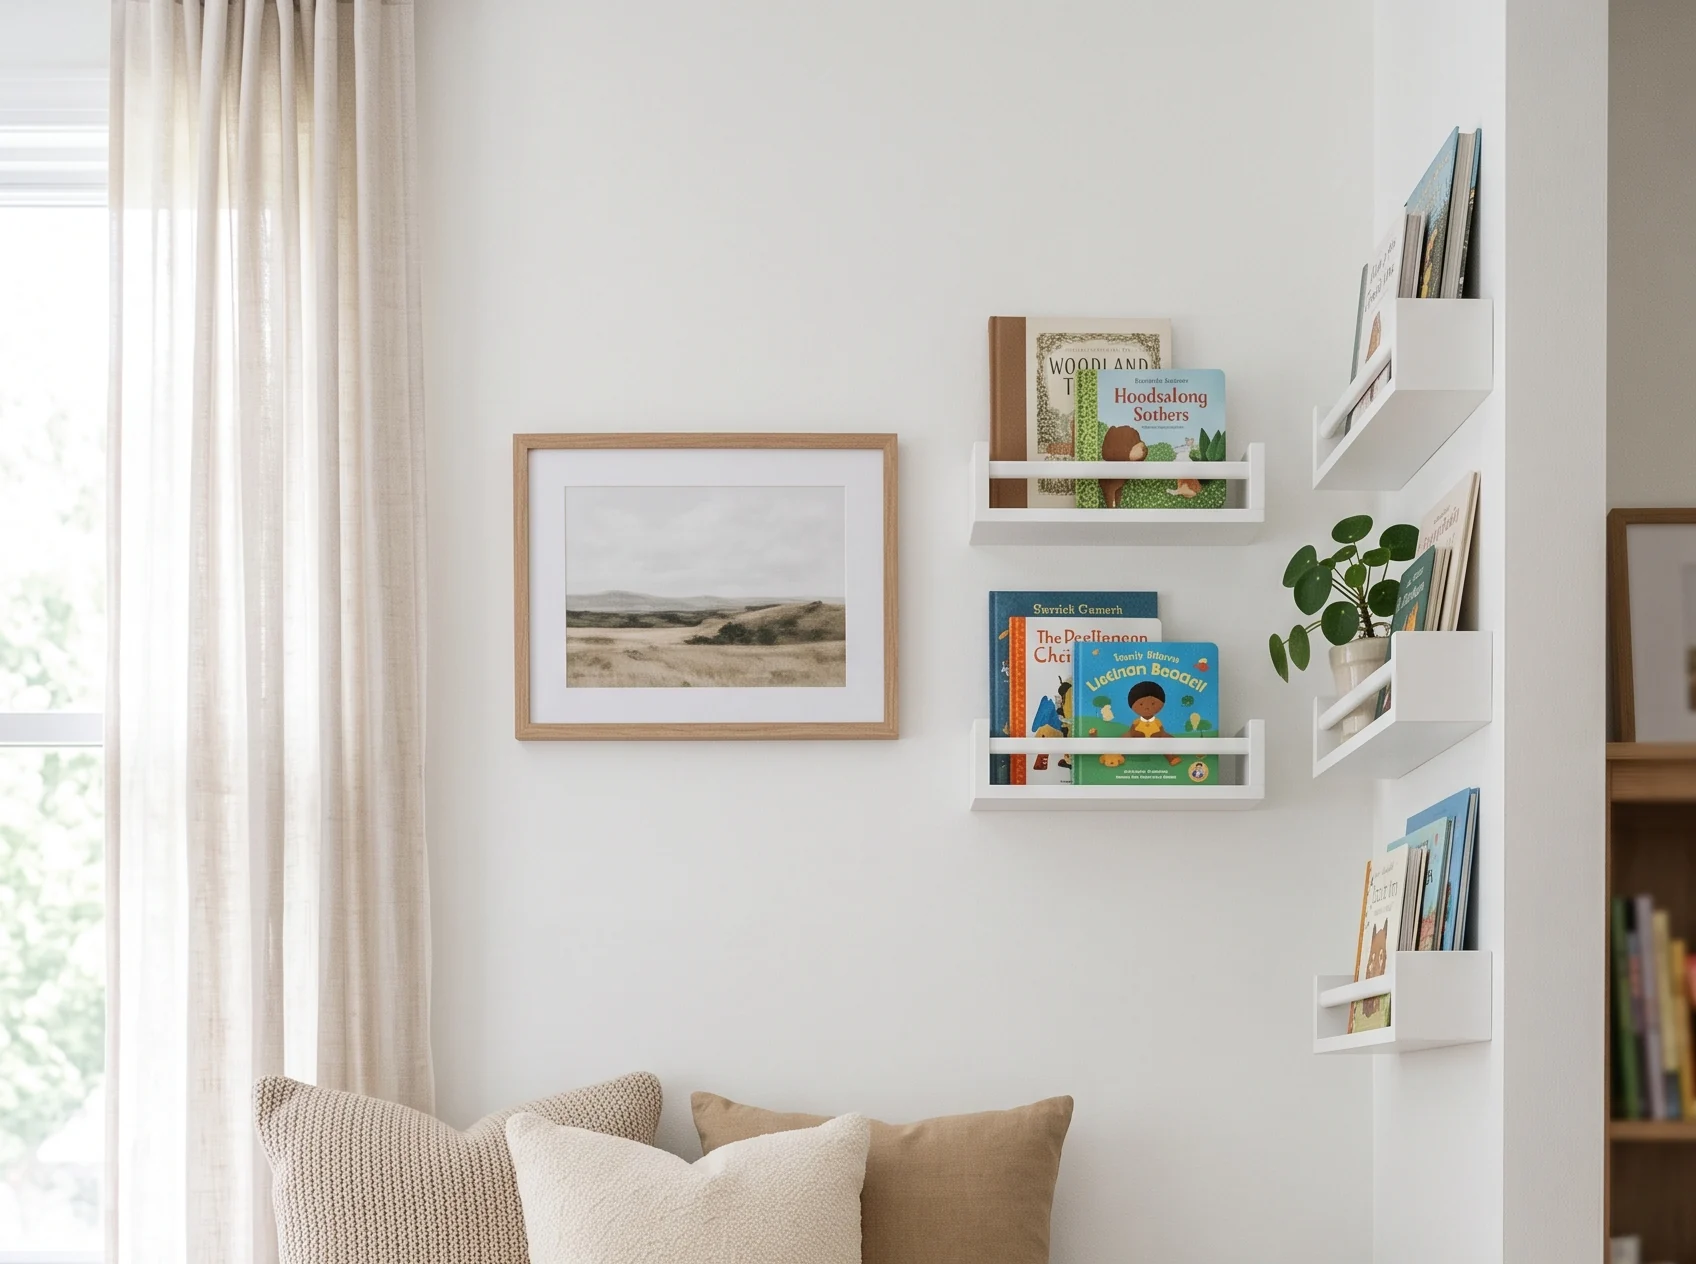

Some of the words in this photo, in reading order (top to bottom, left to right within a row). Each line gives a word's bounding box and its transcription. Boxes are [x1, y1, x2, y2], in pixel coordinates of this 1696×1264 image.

[1114, 386, 1208, 409] Hoodsalong
[1133, 406, 1189, 422] Sothers
[1036, 629, 1062, 644] The
